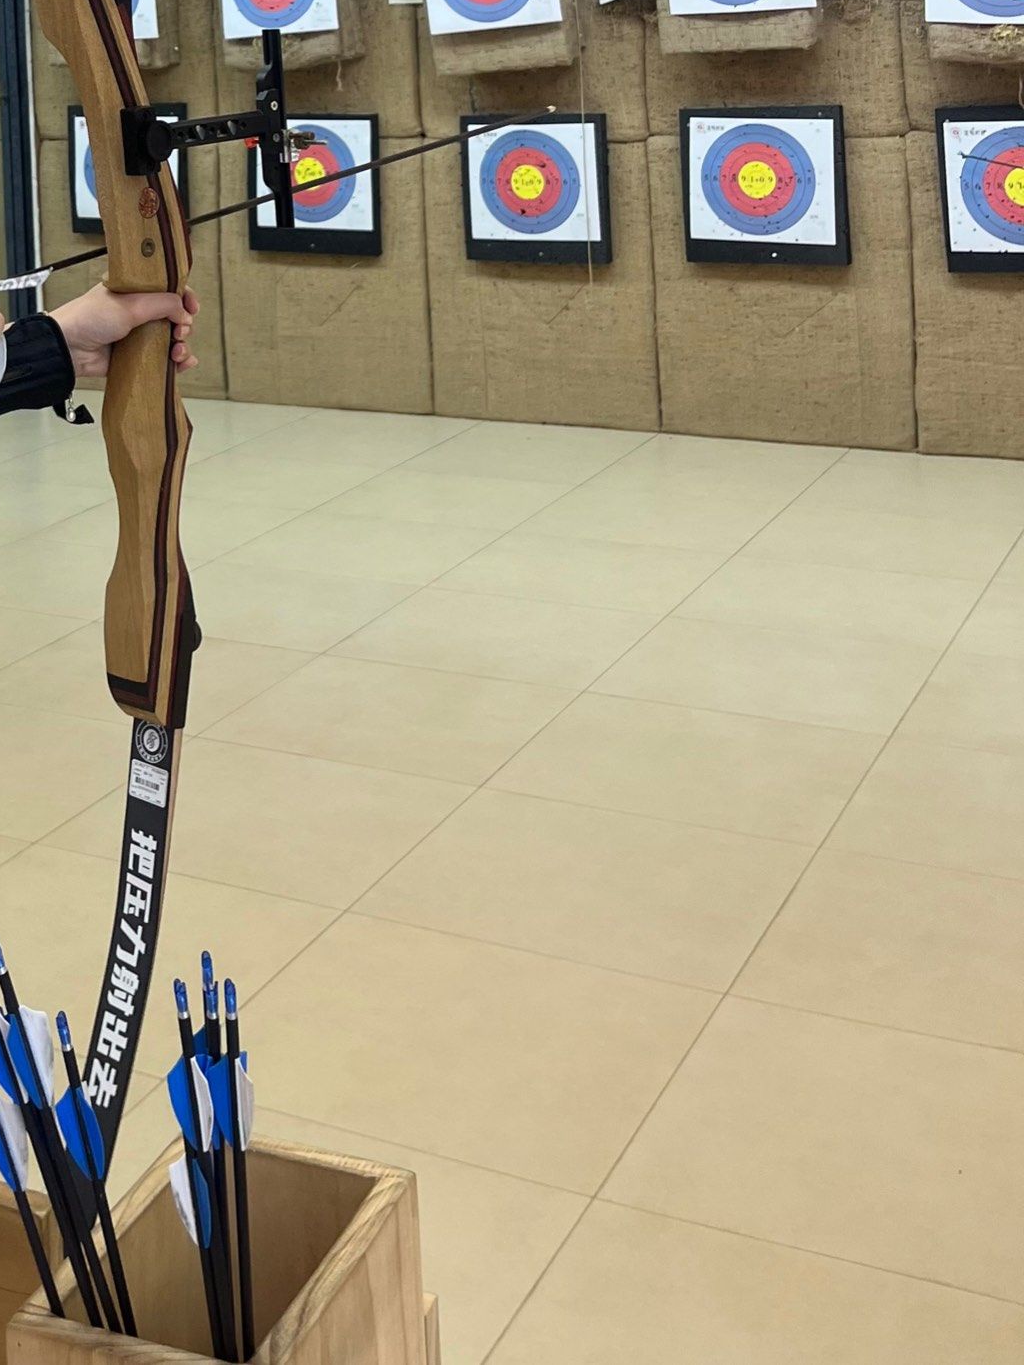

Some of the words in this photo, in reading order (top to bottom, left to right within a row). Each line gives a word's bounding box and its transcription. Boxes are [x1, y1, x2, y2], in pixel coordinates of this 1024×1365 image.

[82, 827, 157, 1108] 把压力射出去
